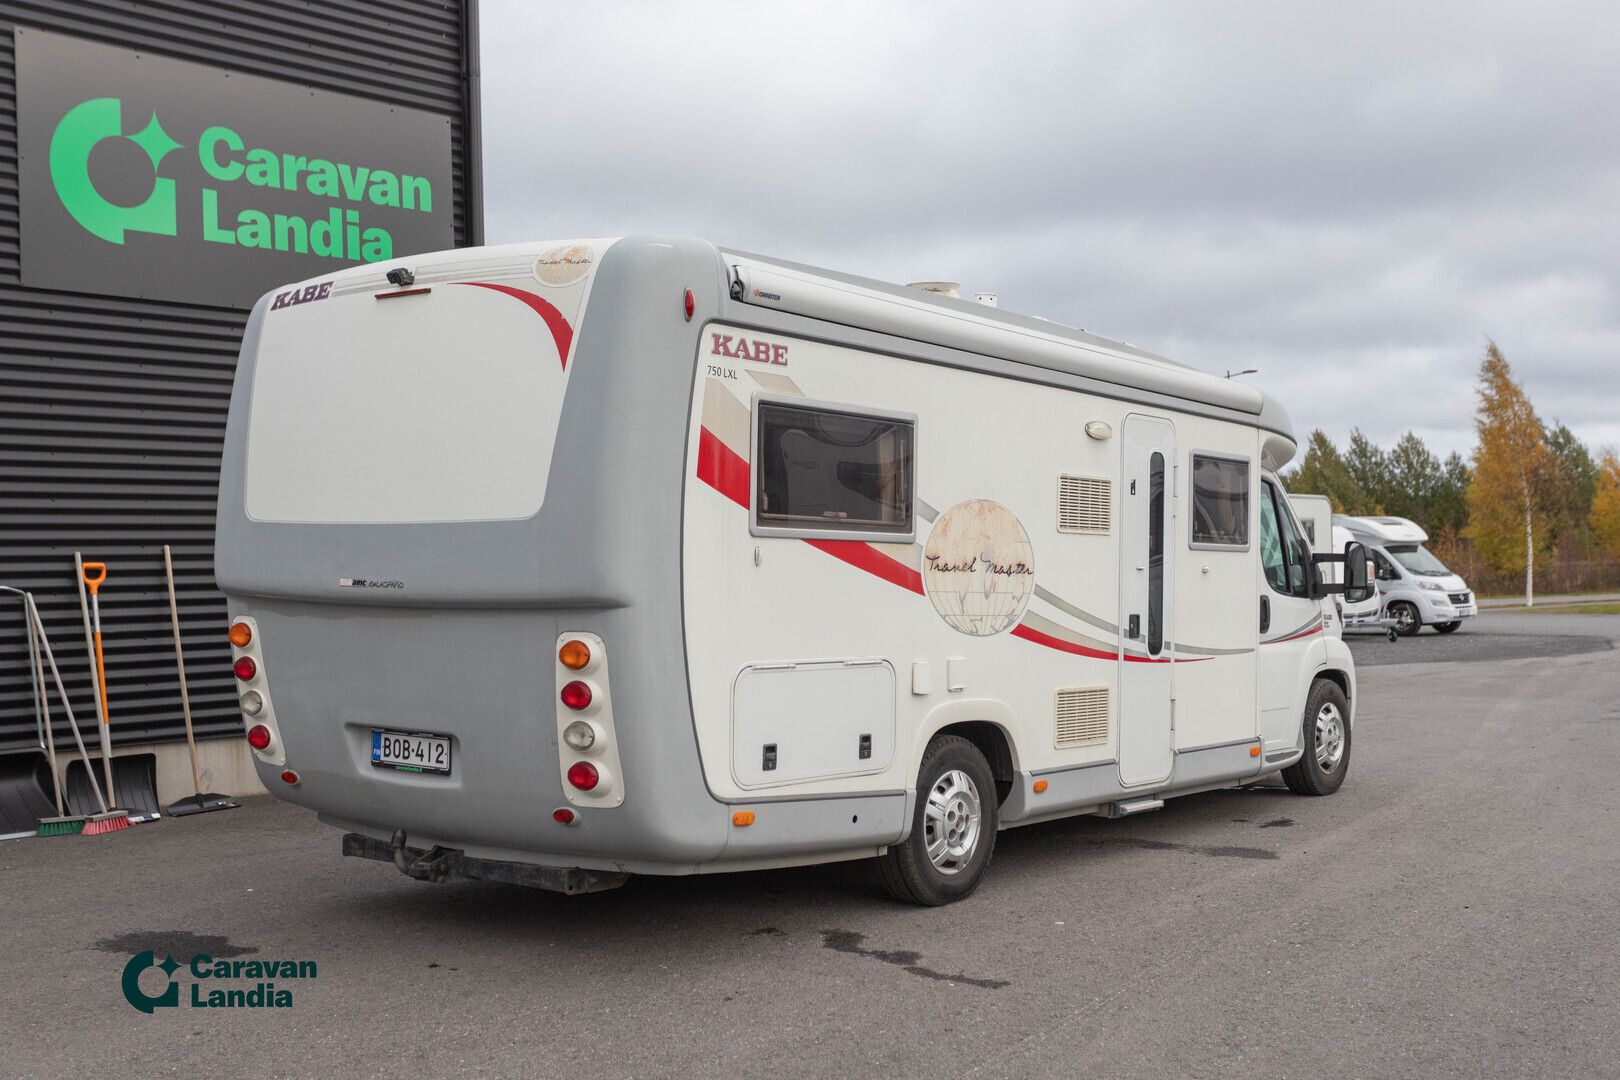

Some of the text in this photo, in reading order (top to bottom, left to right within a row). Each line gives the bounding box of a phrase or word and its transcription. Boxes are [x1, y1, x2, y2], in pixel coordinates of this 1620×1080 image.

[199, 126, 432, 212] Caravan
[202, 188, 393, 263] Landia
[270, 281, 335, 311] KABE
[712, 333, 788, 366] KABE
[707, 365, 738, 380] 750 LXL
[925, 551, 1034, 577] Travel Master
[383, 737, 445, 764] BOB-412
